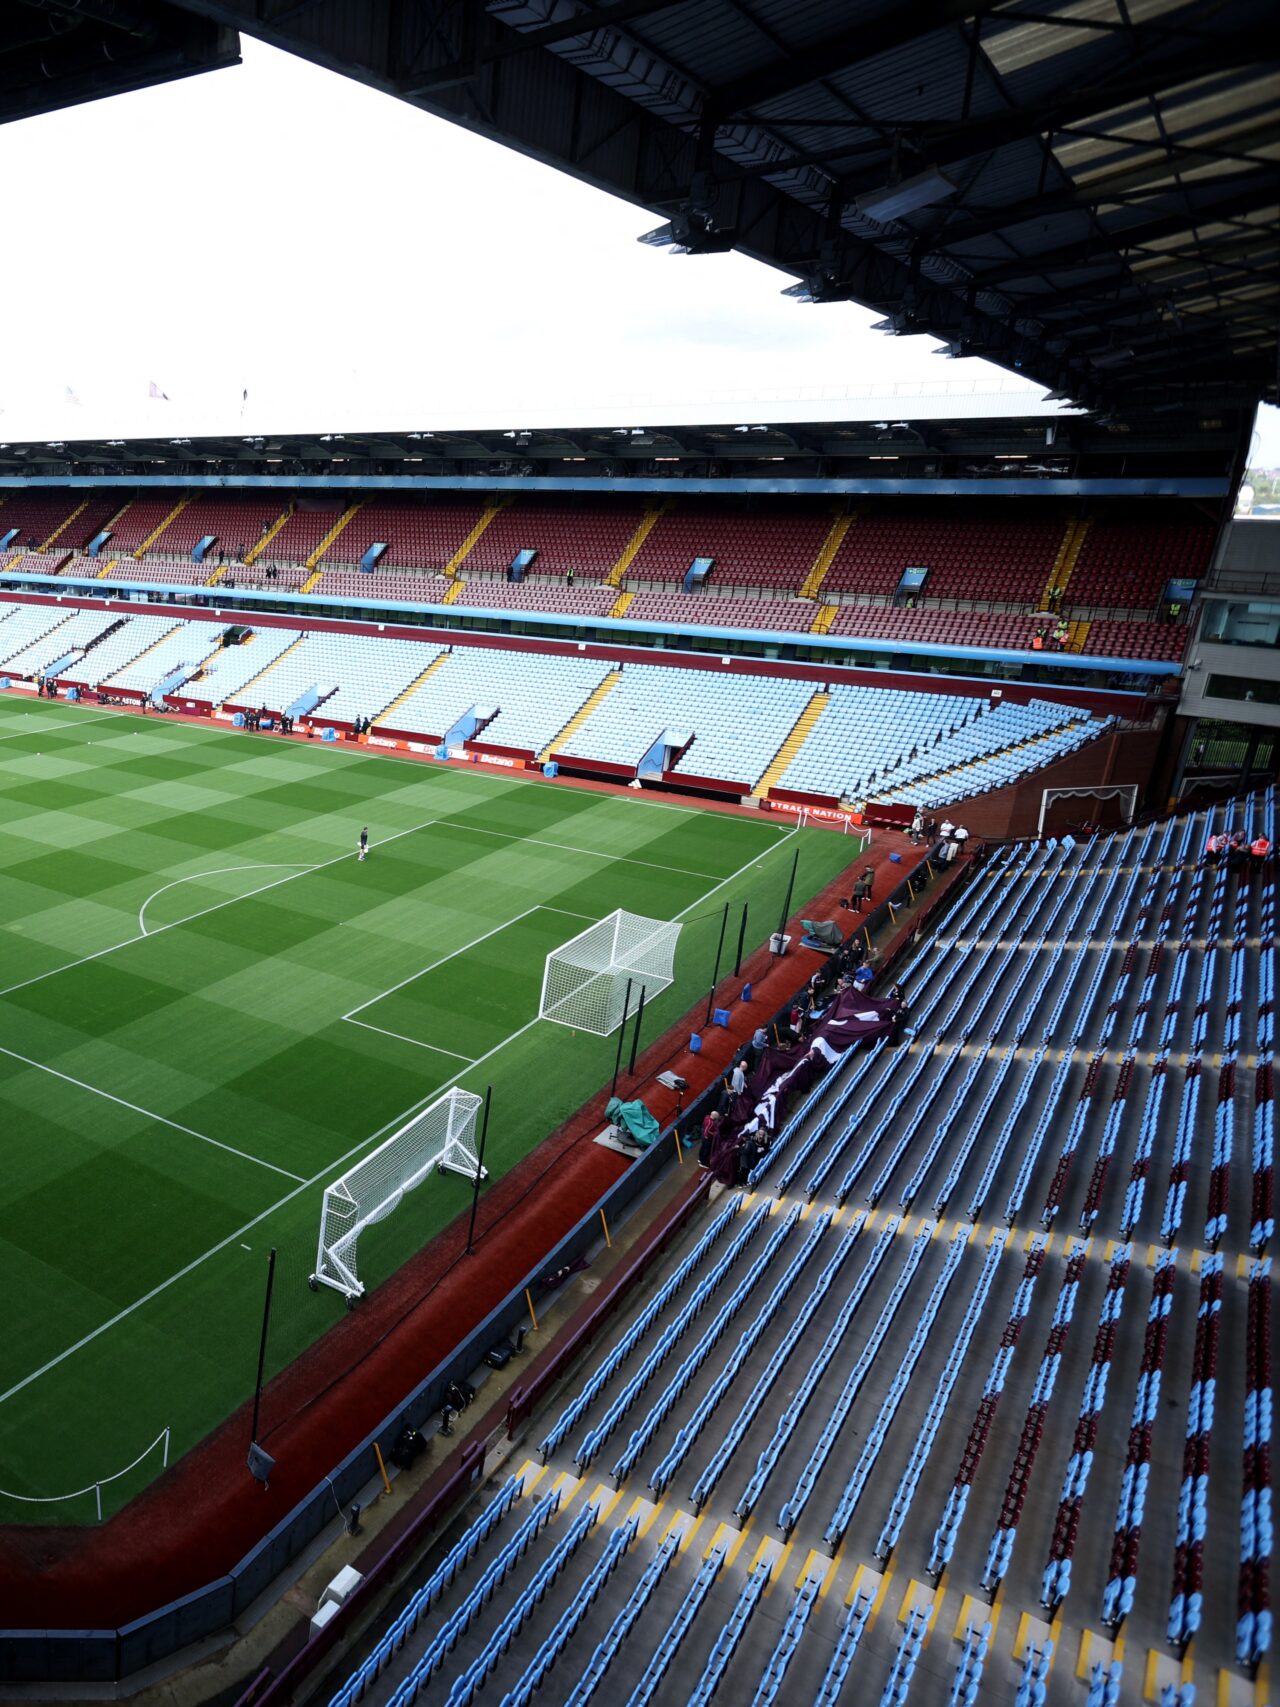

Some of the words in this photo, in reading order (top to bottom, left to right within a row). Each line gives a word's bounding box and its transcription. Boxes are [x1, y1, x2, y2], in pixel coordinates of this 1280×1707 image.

[122, 697, 141, 706] ASTON
[481, 754, 513, 766] Betano
[813, 810, 852, 820] NATION
